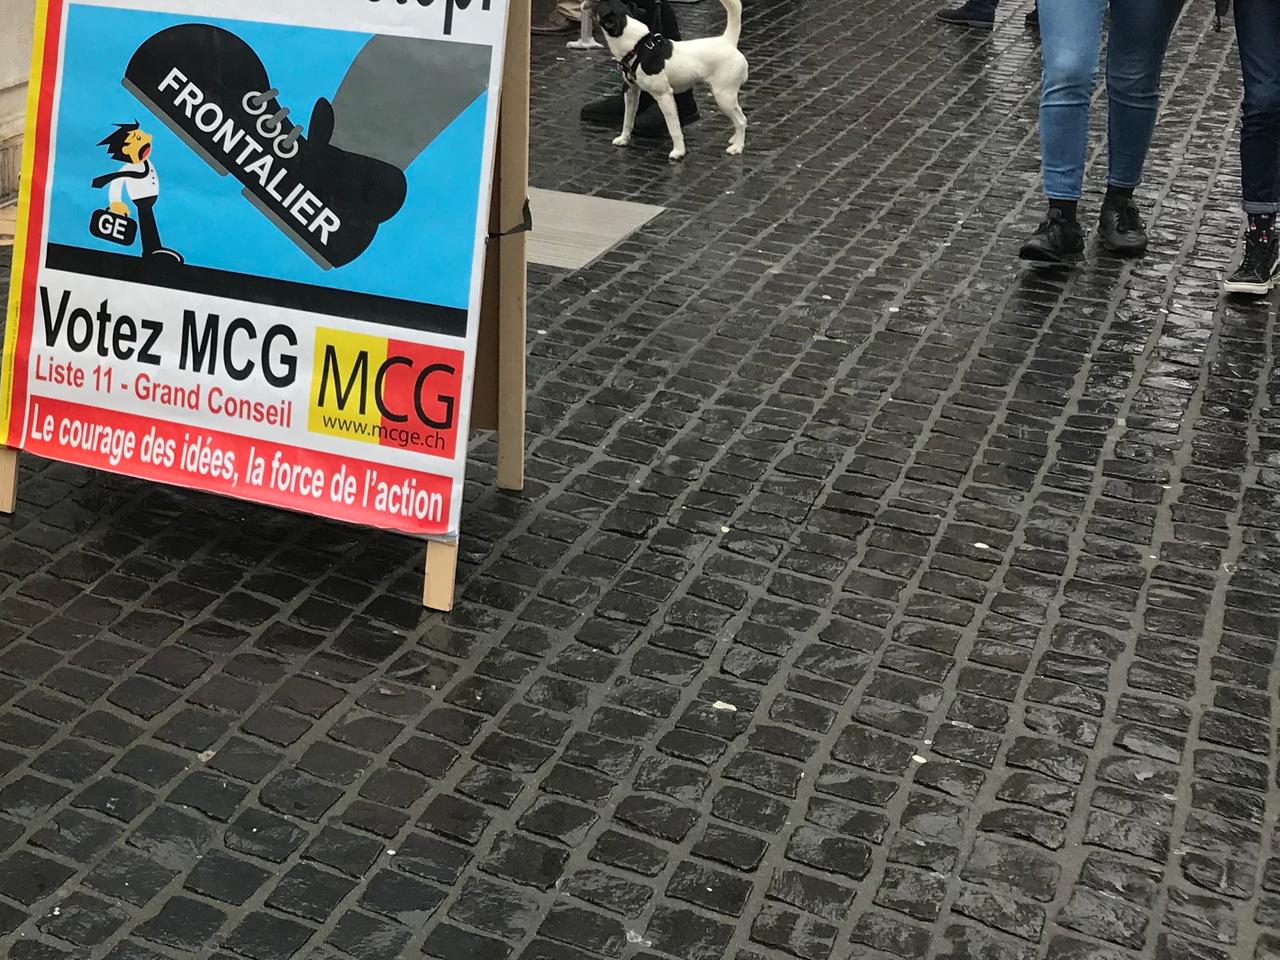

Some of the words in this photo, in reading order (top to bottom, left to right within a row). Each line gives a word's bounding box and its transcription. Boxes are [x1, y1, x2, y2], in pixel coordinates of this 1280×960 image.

[157, 66, 341, 246] FRONTALIER
[97, 213, 128, 240] GE
[38, 285, 164, 367] Votez
[178, 309, 299, 388] MCG
[34, 353, 86, 390] Liste
[92, 365, 113, 395] 11
[134, 371, 202, 412] Grand
[207, 387, 293, 429] Conseil
[317, 344, 456, 430] MCG
[31, 402, 56, 442] Le
[58, 414, 137, 466] courage
[141, 427, 177, 469] des
[180, 436, 238, 489] idées,
[246, 447, 267, 483] la
[270, 451, 326, 499] force
[329, 462, 357, 505] de
[361, 468, 443, 523] l’action
[322, 413, 446, 451] www.mcge.ch
